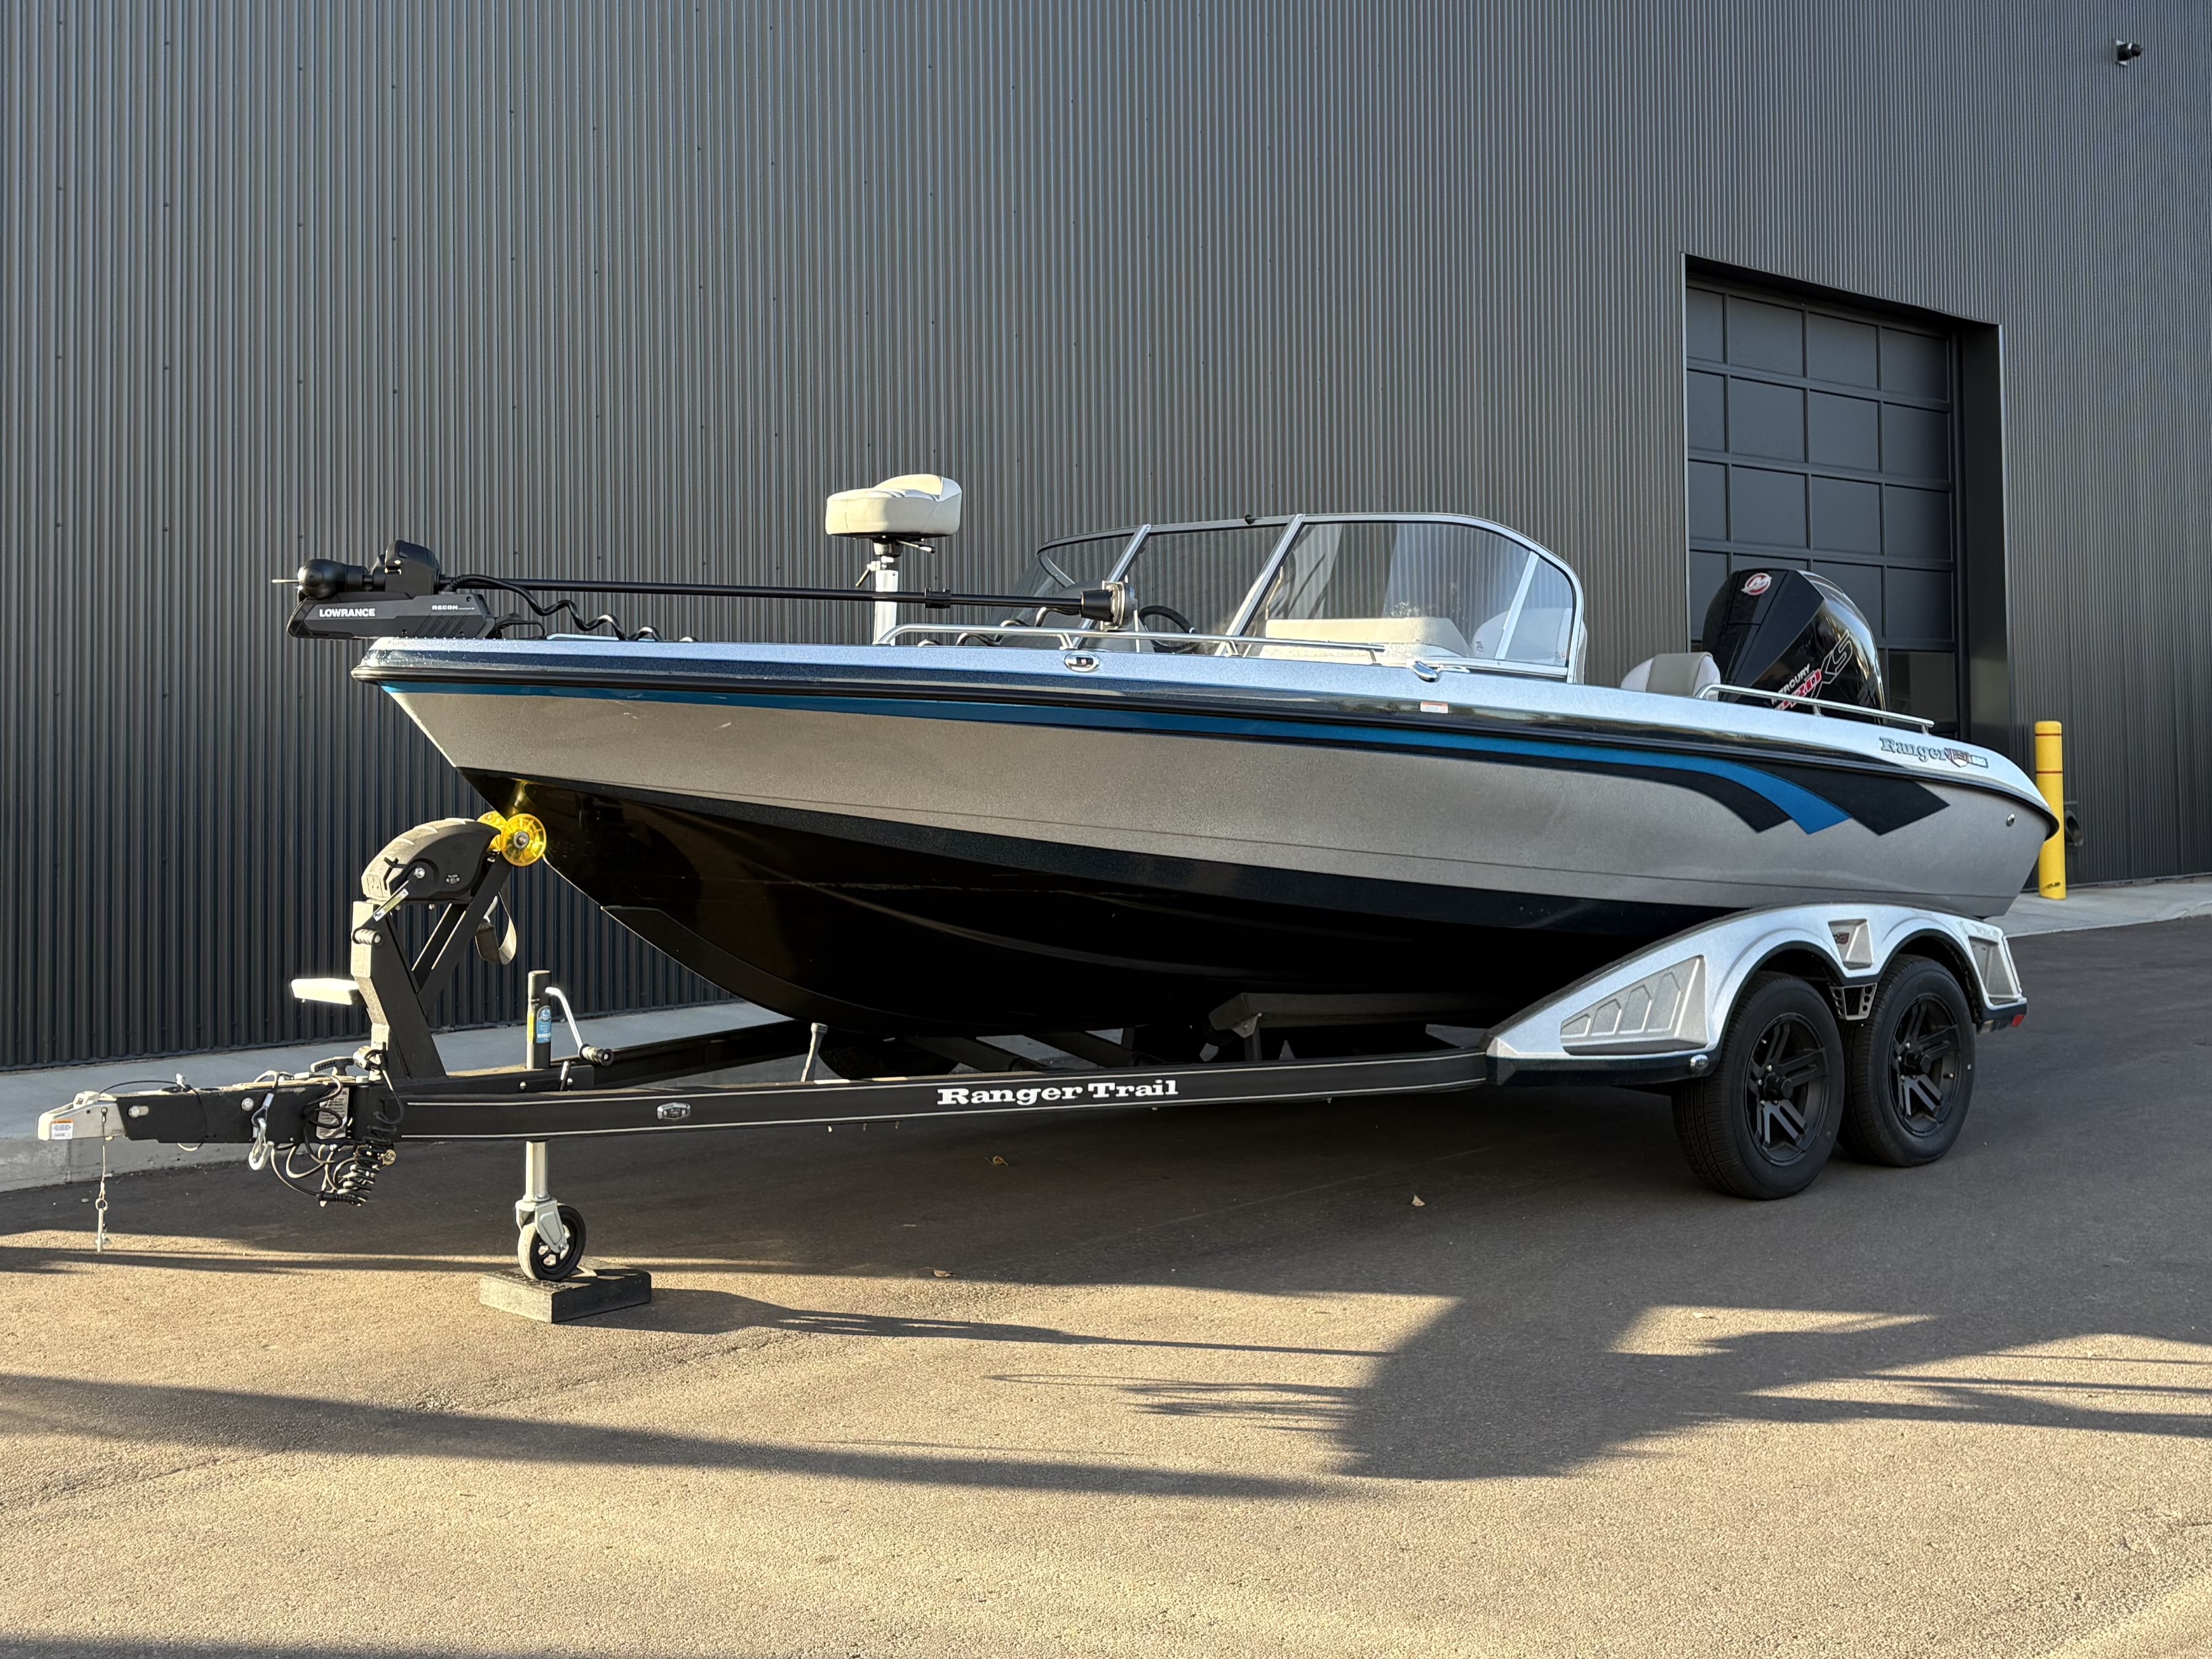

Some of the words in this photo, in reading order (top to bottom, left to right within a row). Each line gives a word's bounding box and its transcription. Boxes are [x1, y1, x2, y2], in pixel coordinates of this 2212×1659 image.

[319, 608, 376, 617] LOWRANCE
[1879, 736, 1947, 762] Ranger
[937, 1086, 1083, 1105] Ranger
[1088, 1080, 1178, 1099] Trail
